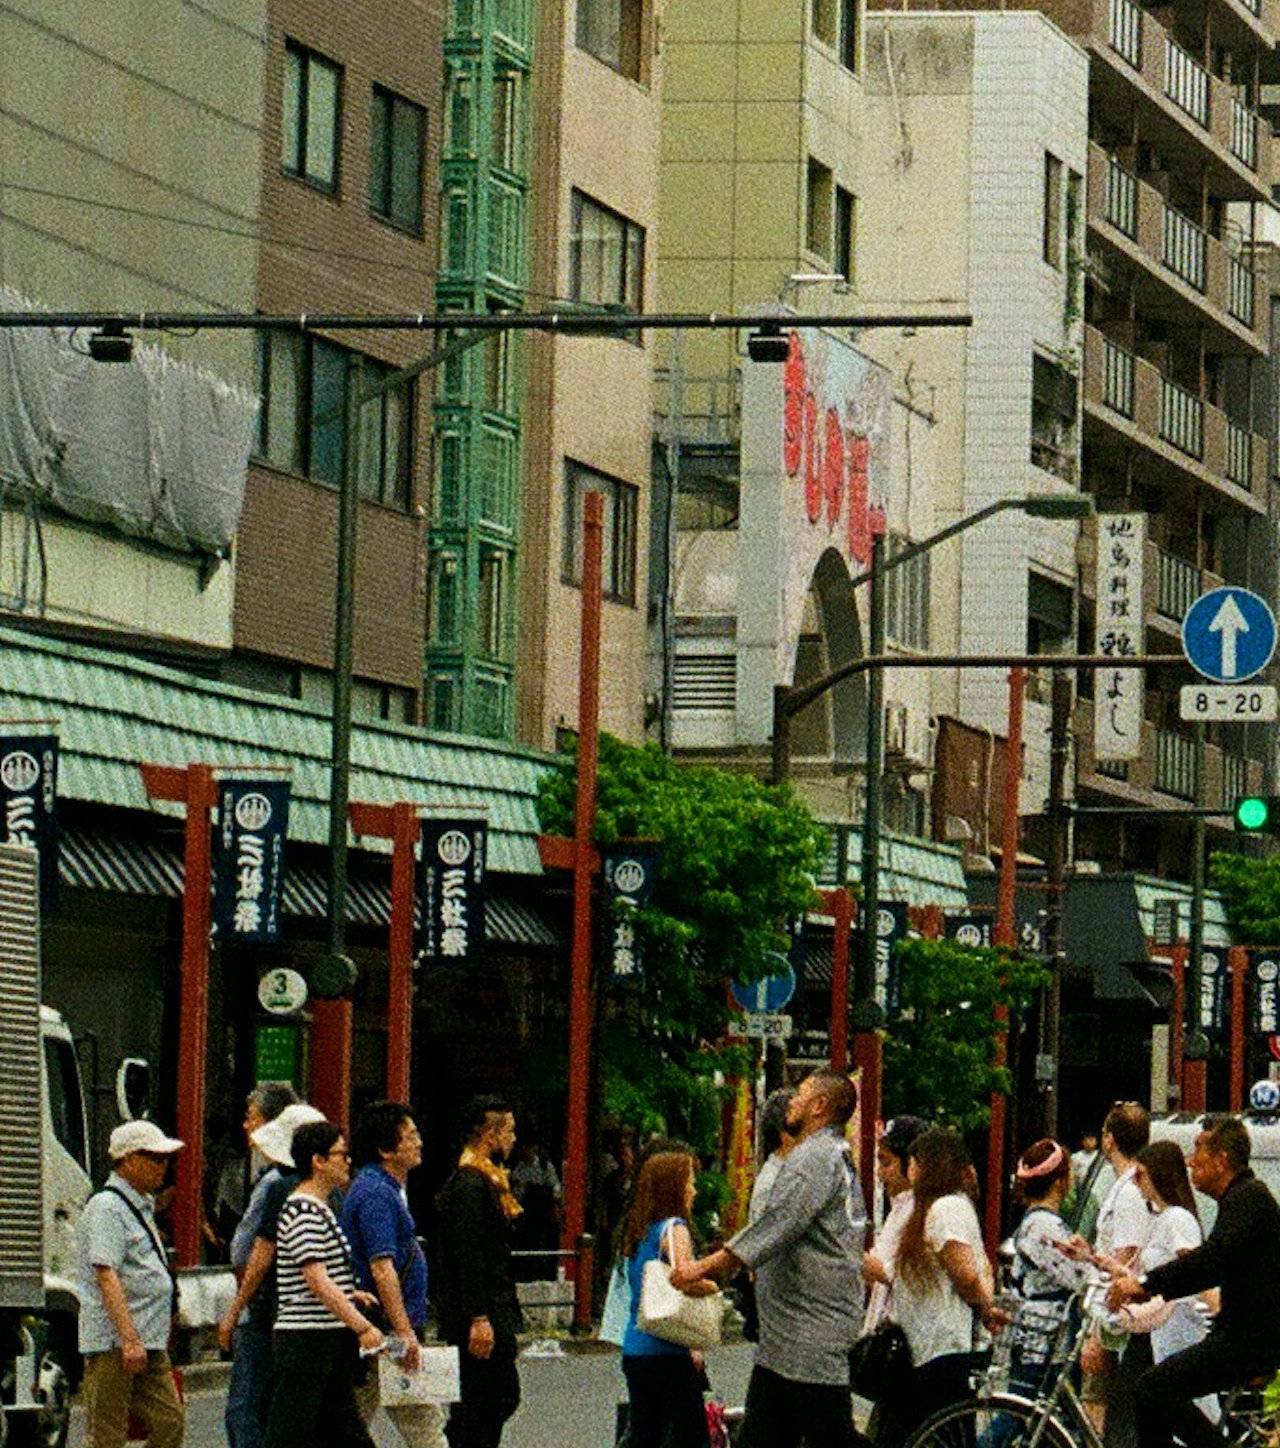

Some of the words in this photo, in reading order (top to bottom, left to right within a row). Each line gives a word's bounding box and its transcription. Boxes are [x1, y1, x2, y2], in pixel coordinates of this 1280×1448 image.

[440, 868, 469, 958] 三社祭
[275, 972, 288, 995] 3
